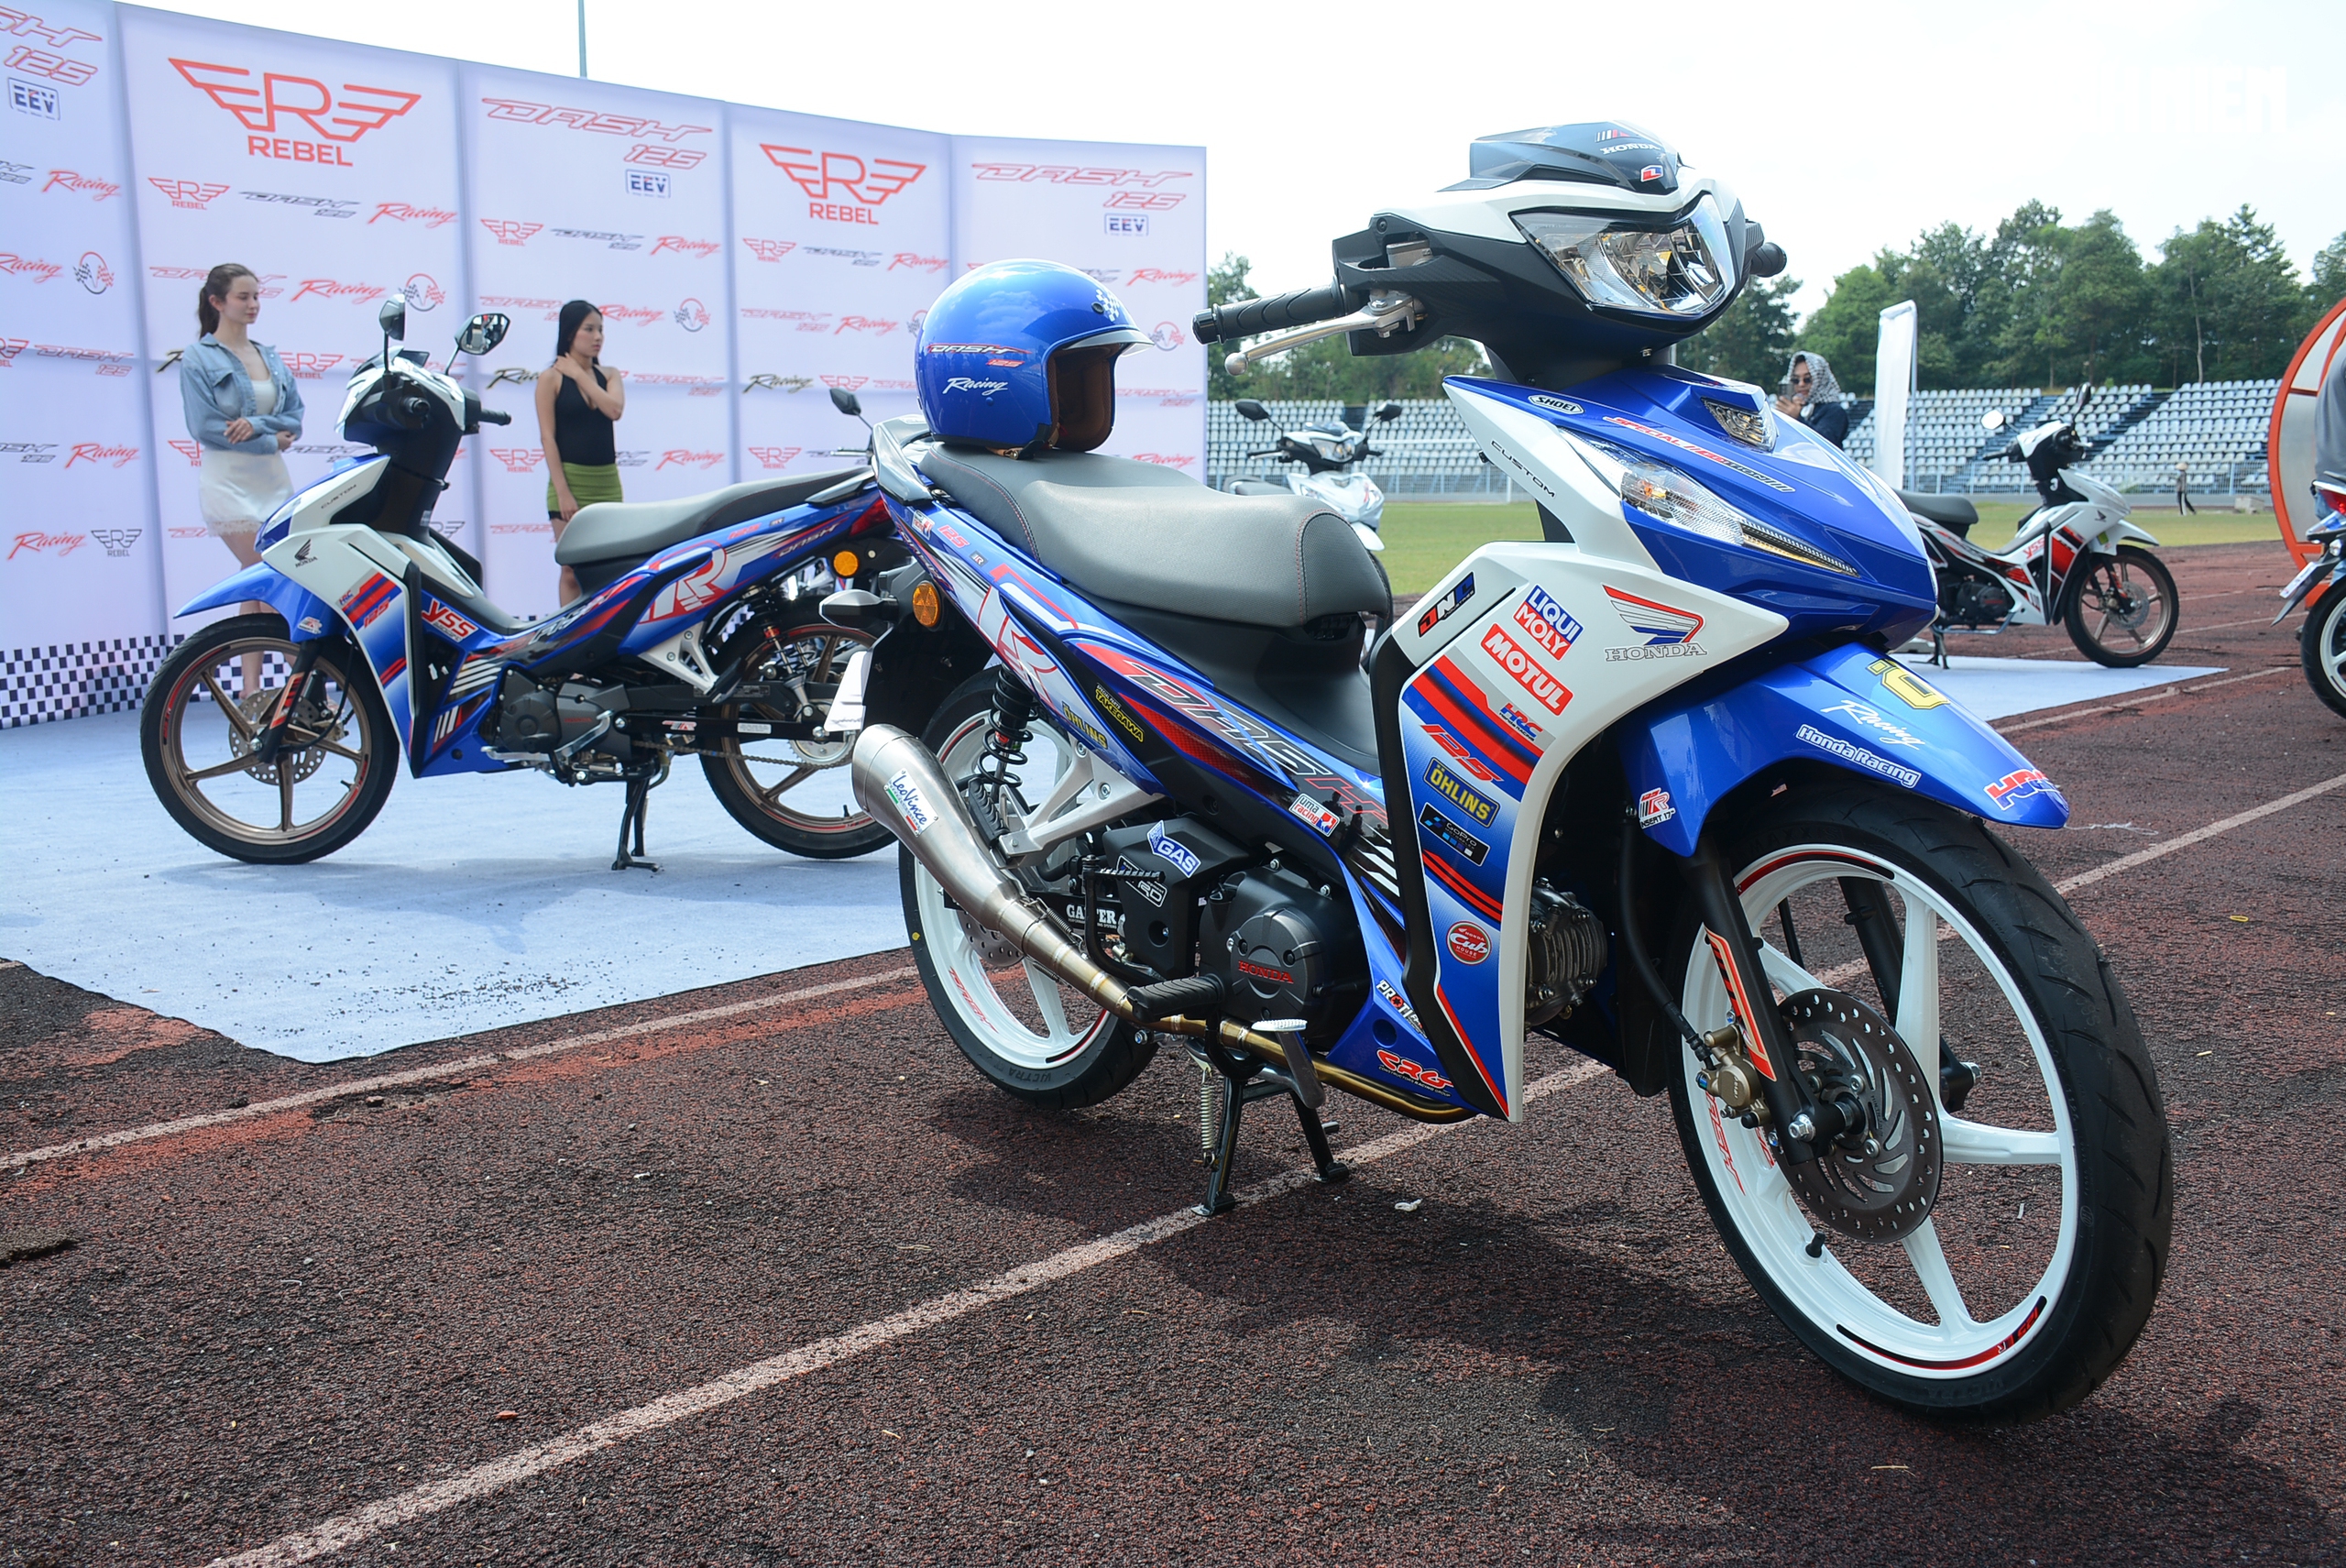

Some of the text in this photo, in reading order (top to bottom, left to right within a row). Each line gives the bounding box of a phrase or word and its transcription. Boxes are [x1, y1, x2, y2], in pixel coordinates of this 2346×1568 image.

[4, 45, 98, 86] 125
[14, 85, 57, 115] EEV
[482, 97, 713, 142] DASH
[247, 136, 354, 167] REBEL
[623, 144, 707, 170] 125
[1599, 142, 1661, 155] HONDA
[42, 170, 121, 202] Racing
[630, 174, 666, 194] EEV
[971, 162, 1193, 187] DASH
[171, 200, 207, 211] REBEL
[809, 202, 879, 225] REBEL
[1102, 191, 1187, 211] 125
[368, 203, 457, 228] Racing
[1109, 217, 1146, 233] EEV
[498, 237, 526, 246] REBEL
[650, 236, 722, 258] Racing
[887, 252, 949, 271] Racing
[1126, 269, 1199, 287] Racing
[291, 279, 389, 304] Racing
[833, 315, 900, 336] Racing
[34, 344, 134, 362] DASH
[927, 343, 1033, 355] DASH
[95, 364, 132, 377] 125
[987, 358, 1025, 368] 125
[742, 373, 815, 394] Racing
[942, 377, 1008, 395] Racing
[1537, 397, 1577, 411] SHOEI
[1613, 417, 1682, 446] SPECIAL
[64, 442, 140, 468] Racing
[655, 449, 725, 470] Racing
[1490, 439, 1557, 499] CUSTOM
[7, 532, 86, 560] Racing
[937, 524, 970, 549] 125
[107, 549, 130, 557] REBEL
[294, 555, 318, 568] HONDA
[422, 599, 476, 638] YSS
[1528, 587, 1583, 637] LIQUI
[1514, 602, 1572, 660] MOLY
[1605, 641, 1708, 663] HONDA
[1485, 630, 1566, 711] MOTUL
[1061, 703, 1108, 750] ÖHLINS
[1095, 688, 1145, 742] TAKEGAWA
[1500, 702, 1544, 739] HRC
[1820, 699, 1925, 751] Racing
[1420, 723, 1505, 782] 125
[893, 774, 927, 826] LeoVince
[1299, 795, 1320, 814] uma
[1430, 765, 1492, 821] ÖHLINS
[1294, 804, 1320, 824] racing
[1446, 822, 1477, 847] GoPro
[1157, 839, 1197, 872] GAS
[1450, 933, 1488, 953] Cub
[1455, 945, 1477, 958] HOUSE
[1238, 960, 1294, 984] HONDA
[1376, 980, 1413, 1018] PROTI
[1377, 1050, 1454, 1089] CRG
[1378, 1066, 1451, 1097] CONSTRUCTORS RACING GROUP
